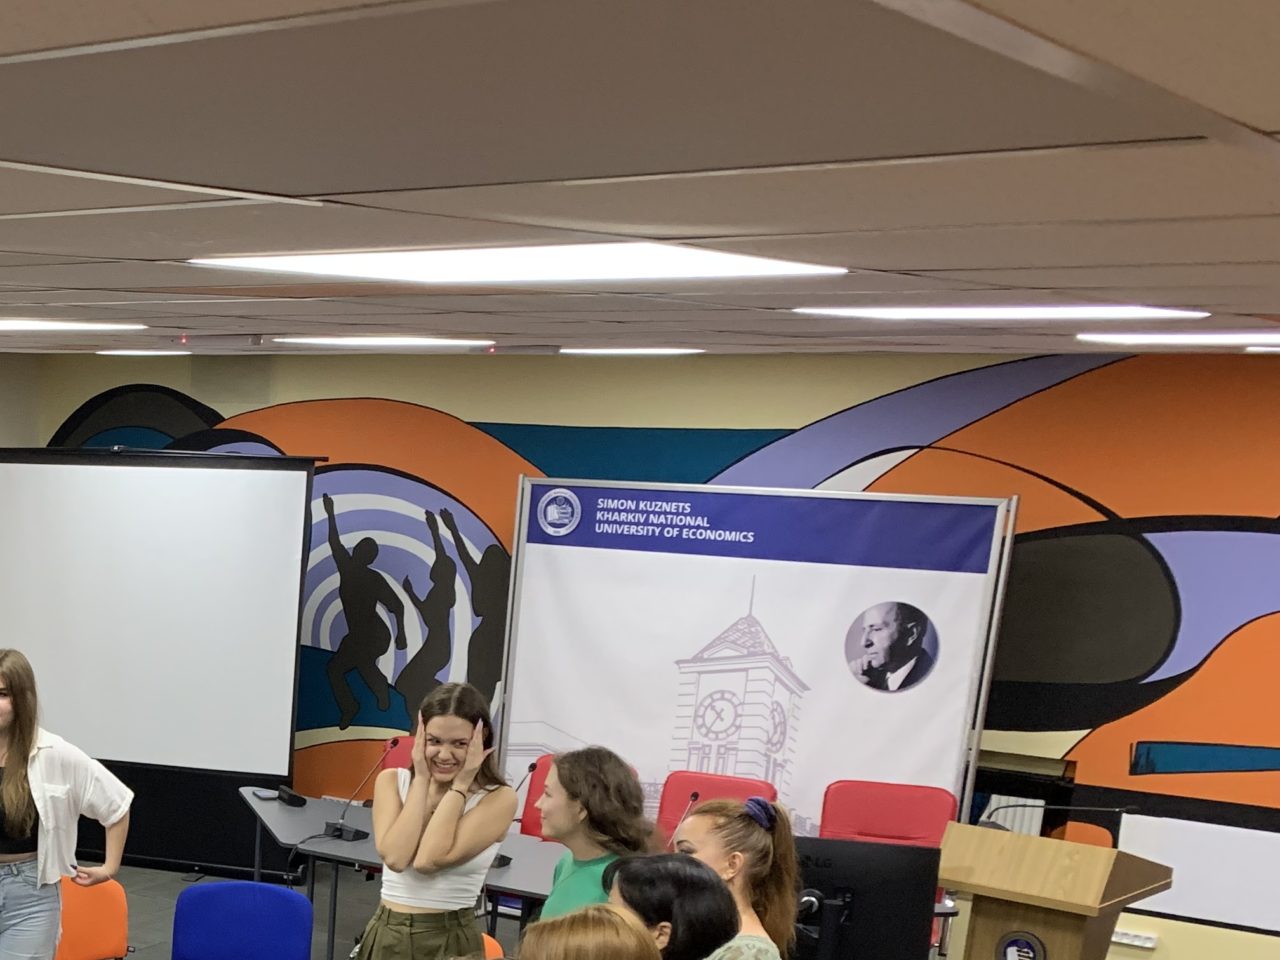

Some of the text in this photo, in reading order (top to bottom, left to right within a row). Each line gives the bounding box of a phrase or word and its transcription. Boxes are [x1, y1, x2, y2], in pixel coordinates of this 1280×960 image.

[597, 498, 692, 513] SIMON KUZNETS
[596, 511, 710, 527] KHARKIV NATIONAL
[595, 523, 755, 543] UNIVERSITY OF ECONOMICS
